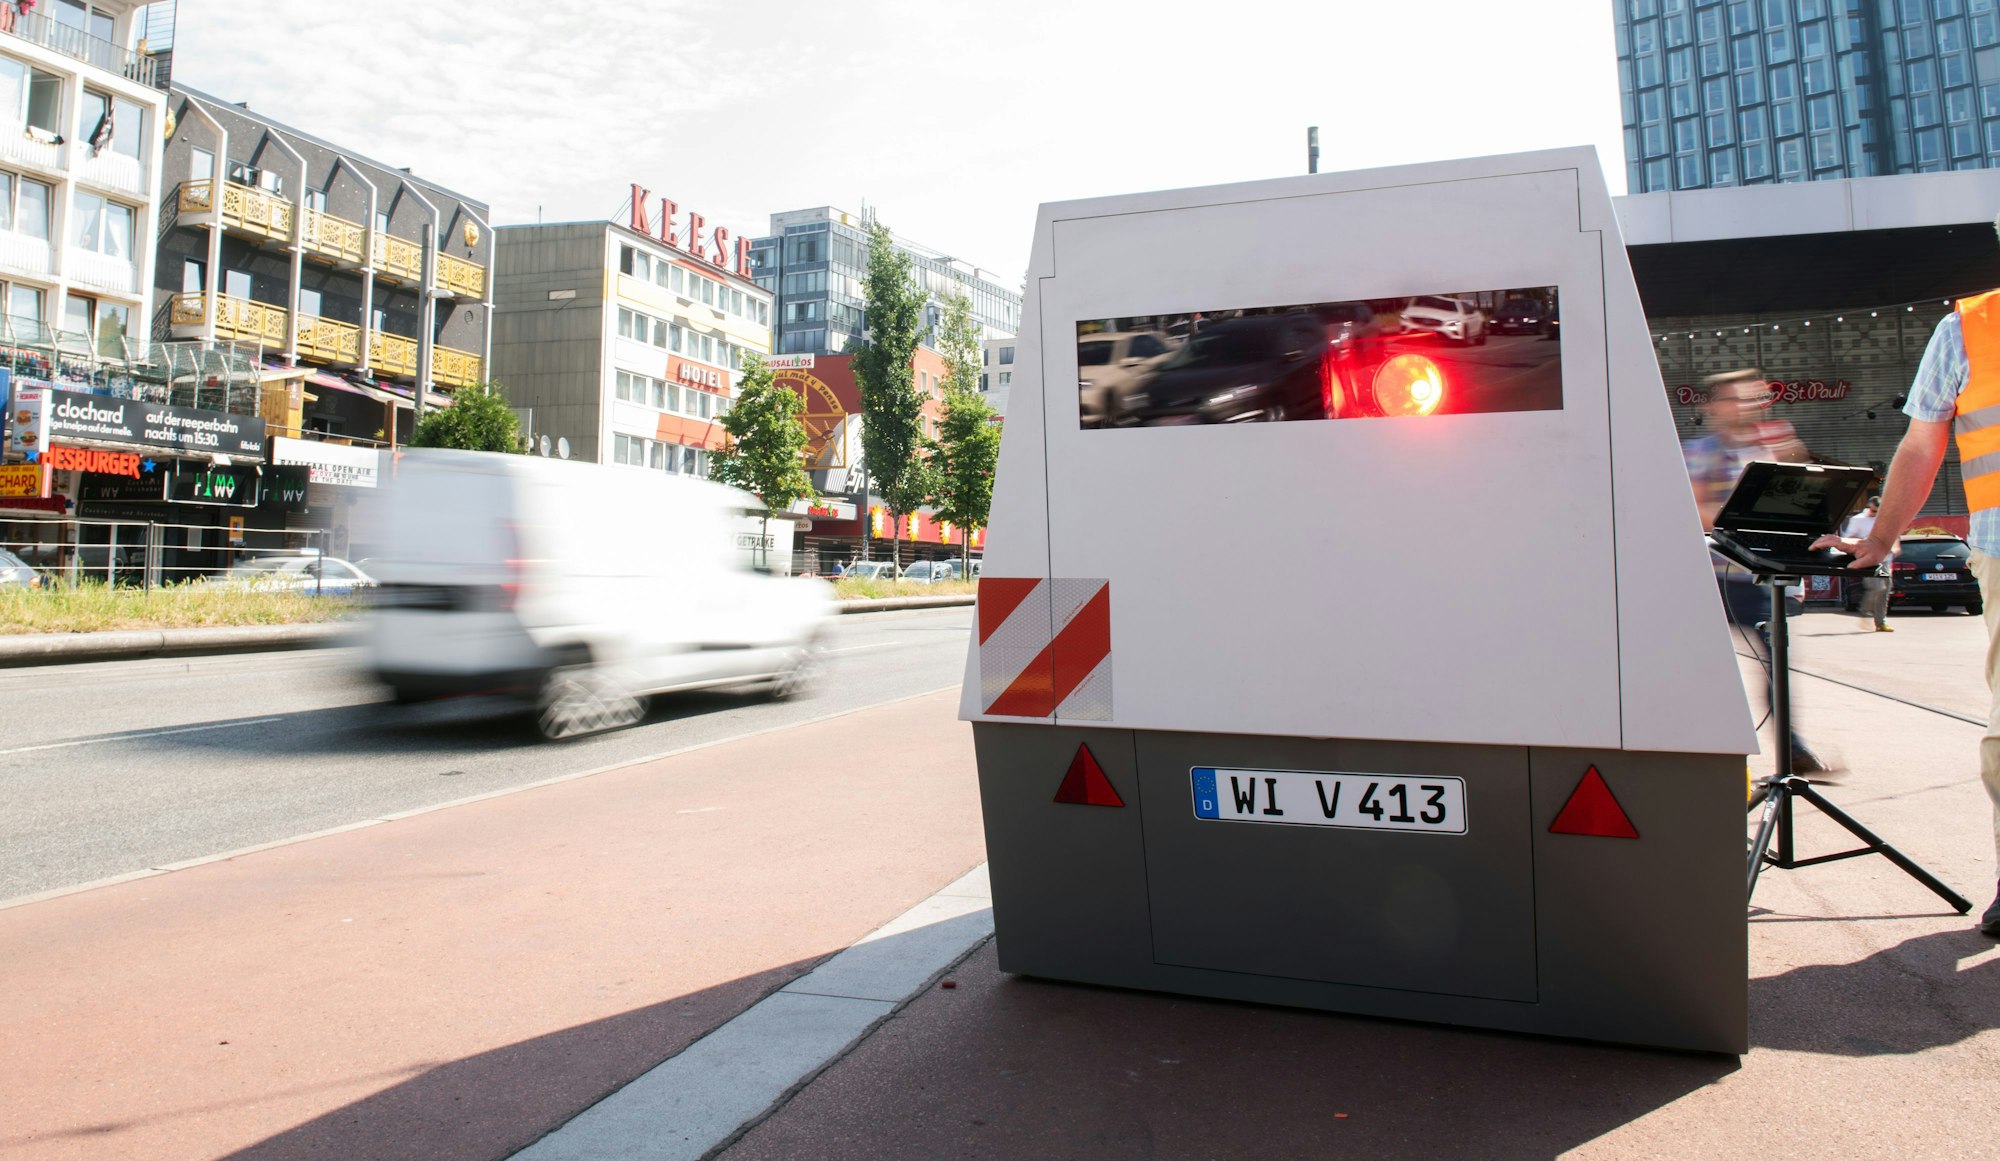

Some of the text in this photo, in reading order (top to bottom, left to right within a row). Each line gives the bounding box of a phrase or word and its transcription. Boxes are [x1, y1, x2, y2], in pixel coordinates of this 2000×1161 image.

[630, 183, 752, 278] KEESE
[680, 362, 722, 389] HOTEL
[1676, 386, 1708, 404] Das
[1783, 382, 1806, 403] St.
[1807, 381, 1847, 400] Pauli
[57, 398, 124, 424] clochard
[146, 411, 239, 434] auf der reeperbahn
[144, 427, 178, 442] nachts
[178, 434, 194, 444] um
[1203, 800, 1212, 811] D
[1231, 776, 1446, 825] WI V 413
